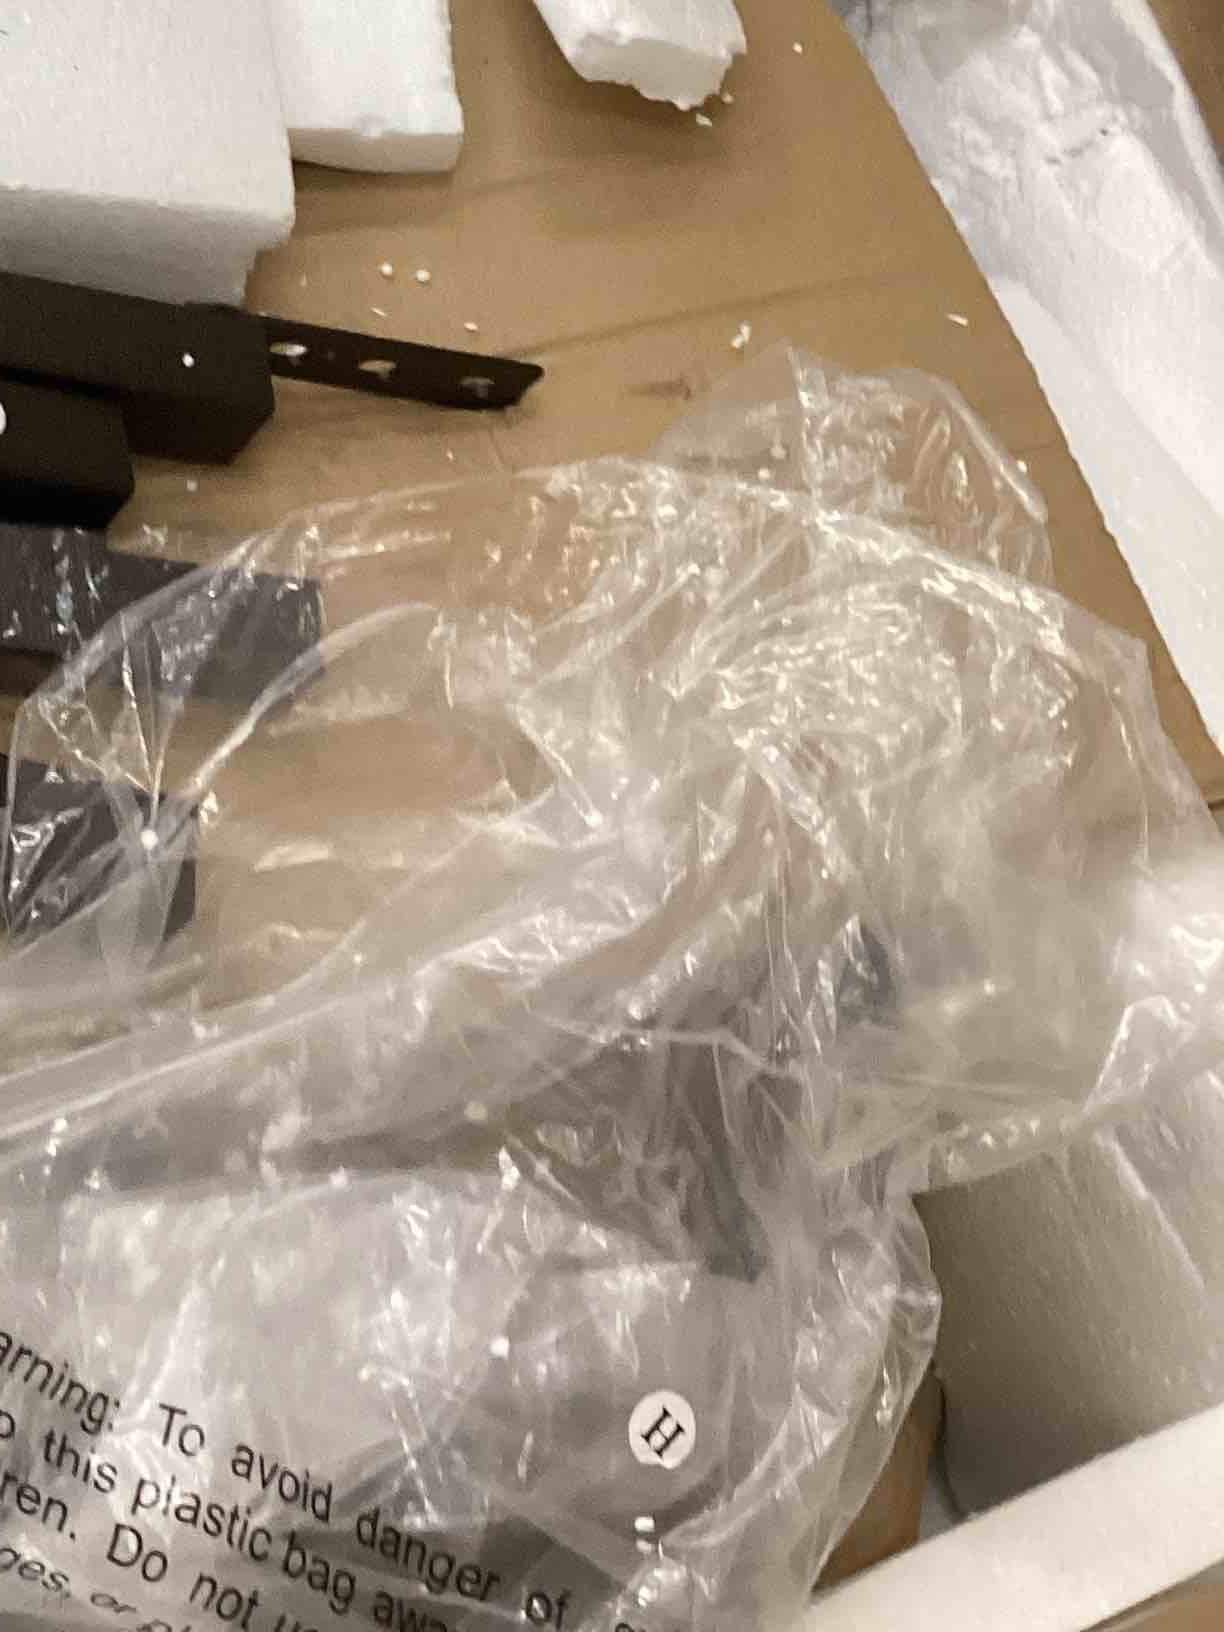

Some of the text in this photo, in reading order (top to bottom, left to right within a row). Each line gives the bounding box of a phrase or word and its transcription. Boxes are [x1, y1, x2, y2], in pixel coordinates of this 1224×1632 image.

[640, 1404, 685, 1458] H
[43, 1428, 118, 1494] this
[130, 1474, 273, 1562] plastic
[282, 1530, 357, 1615] bag
[106, 1523, 169, 1582] Do
[189, 1571, 259, 1630] not
[158, 1403, 206, 1457] To
[230, 1444, 333, 1523] avoid
[356, 1504, 501, 1602] danger
[525, 1589, 573, 1631] of
